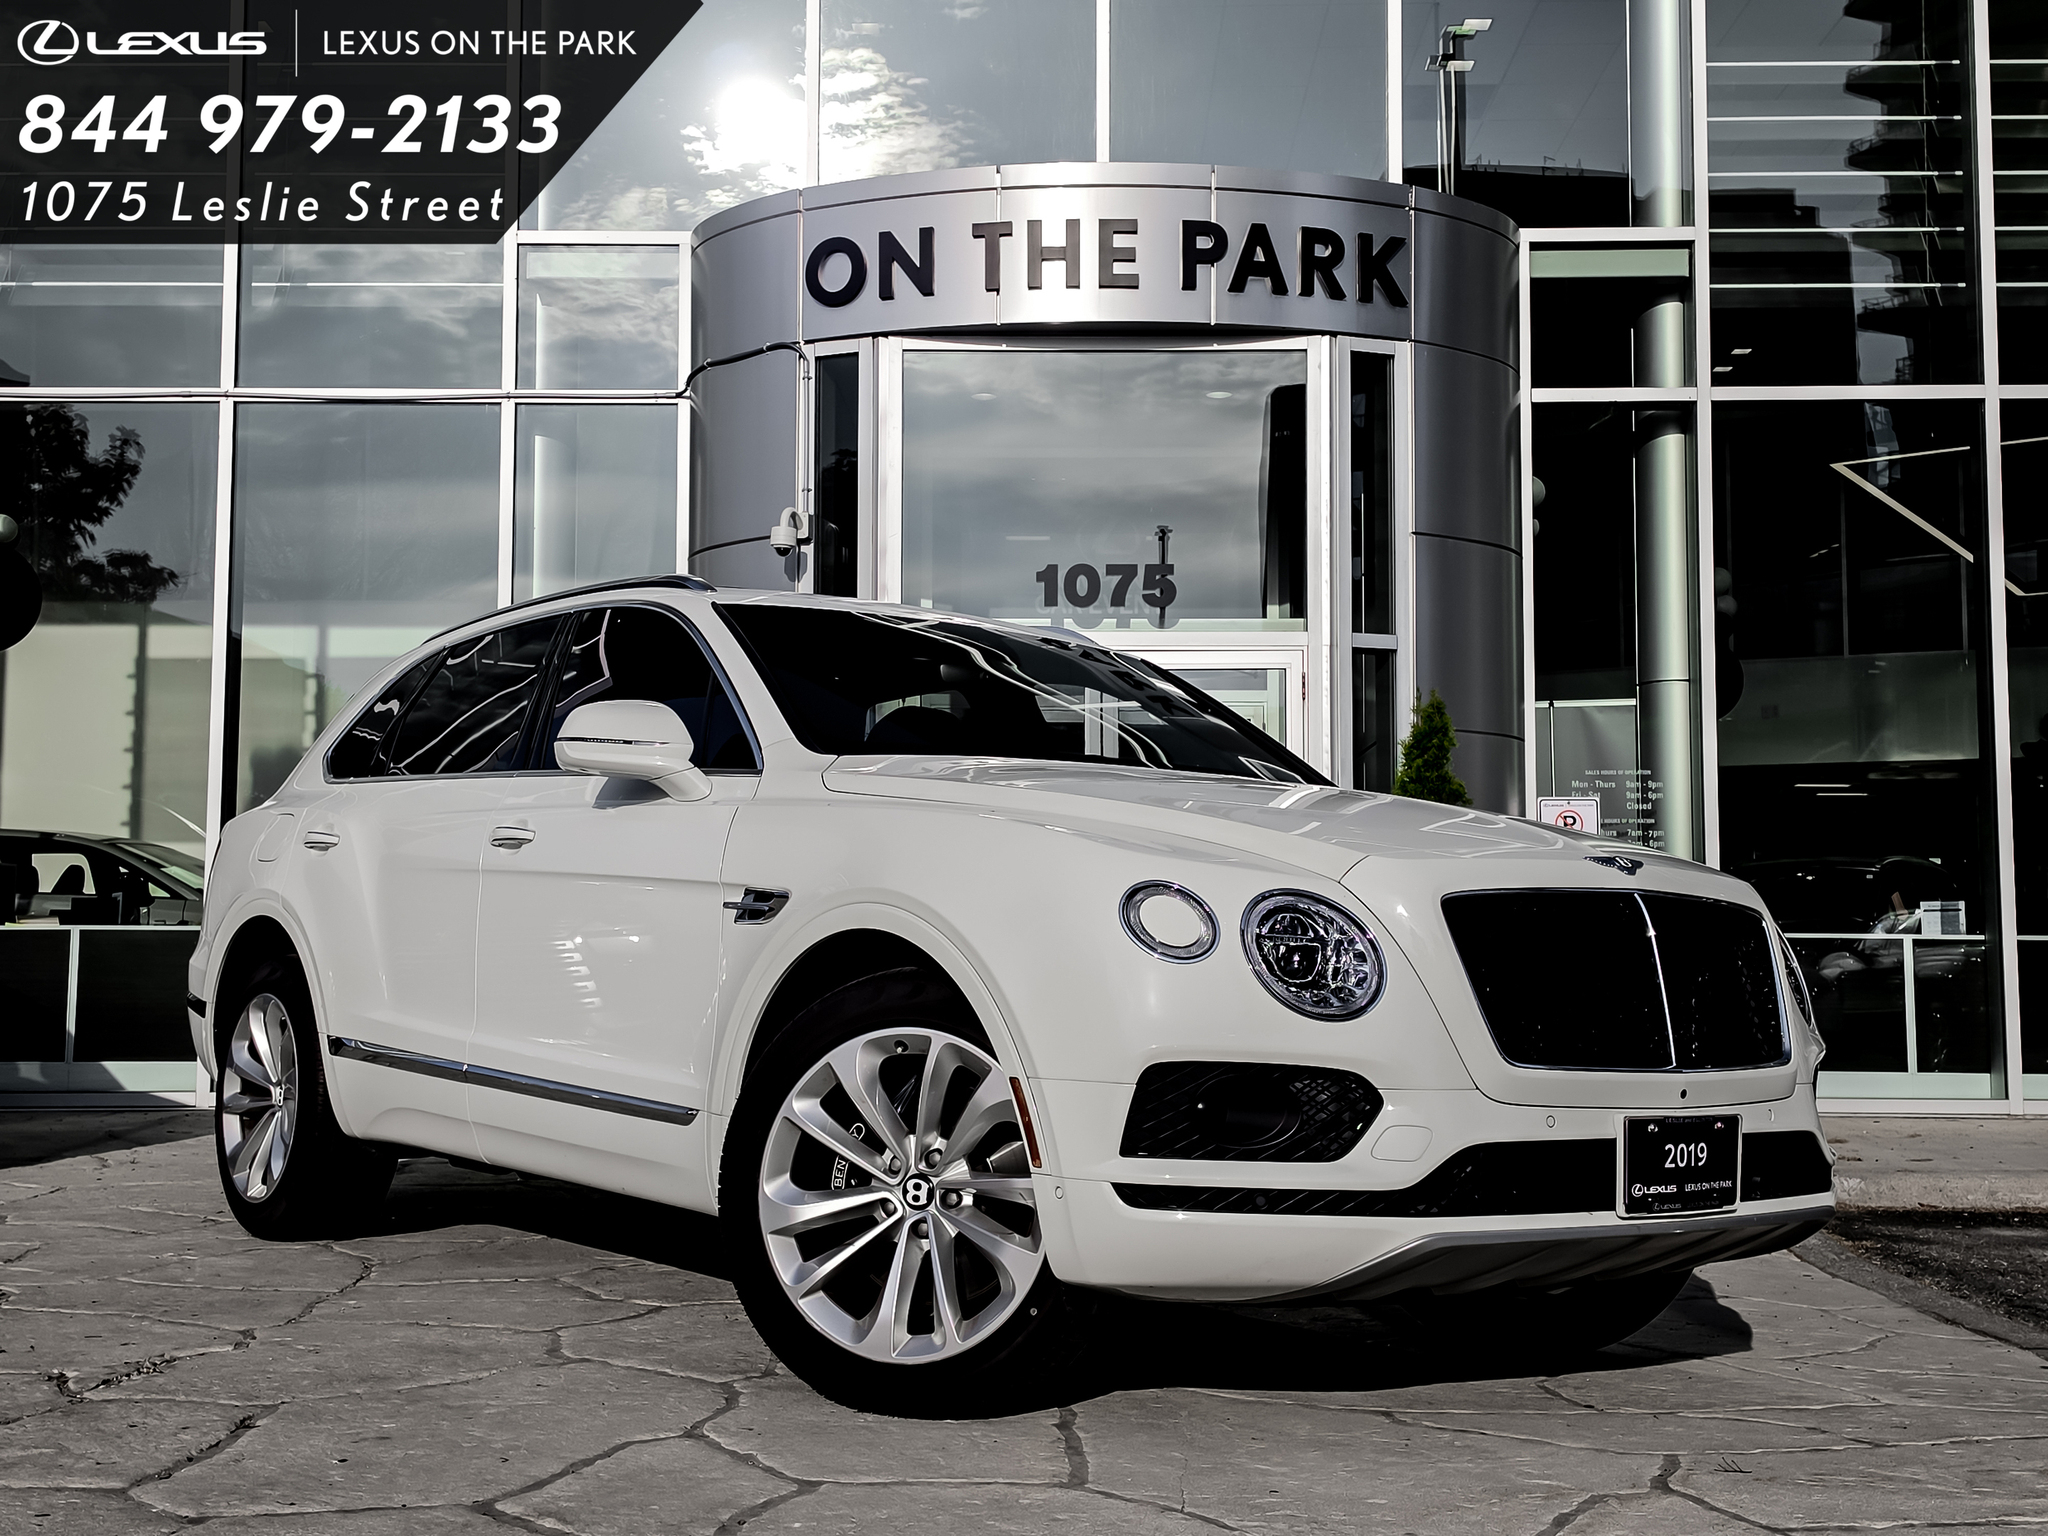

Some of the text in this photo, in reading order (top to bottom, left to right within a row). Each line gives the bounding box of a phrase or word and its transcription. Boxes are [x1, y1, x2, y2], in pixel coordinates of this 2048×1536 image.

[805, 218, 1409, 307] ON THE PARK
[1036, 563, 1177, 608] 1075
[1571, 780, 1588, 788] Mon
[1595, 780, 1616, 788] Thurs
[1626, 780, 1641, 788] 9am
[1648, 780, 1664, 790] 9pm
[1626, 791, 1641, 799] 9am
[1648, 791, 1664, 801] 6pm
[1626, 802, 1652, 810] Closed
[1600, 828, 1617, 837] hurs
[1649, 840, 1666, 848] 6pm
[1664, 1142, 1708, 1168] 2019
[1644, 1184, 1677, 1194] LEXUS
[1684, 1183, 1701, 1192] LEXUS
